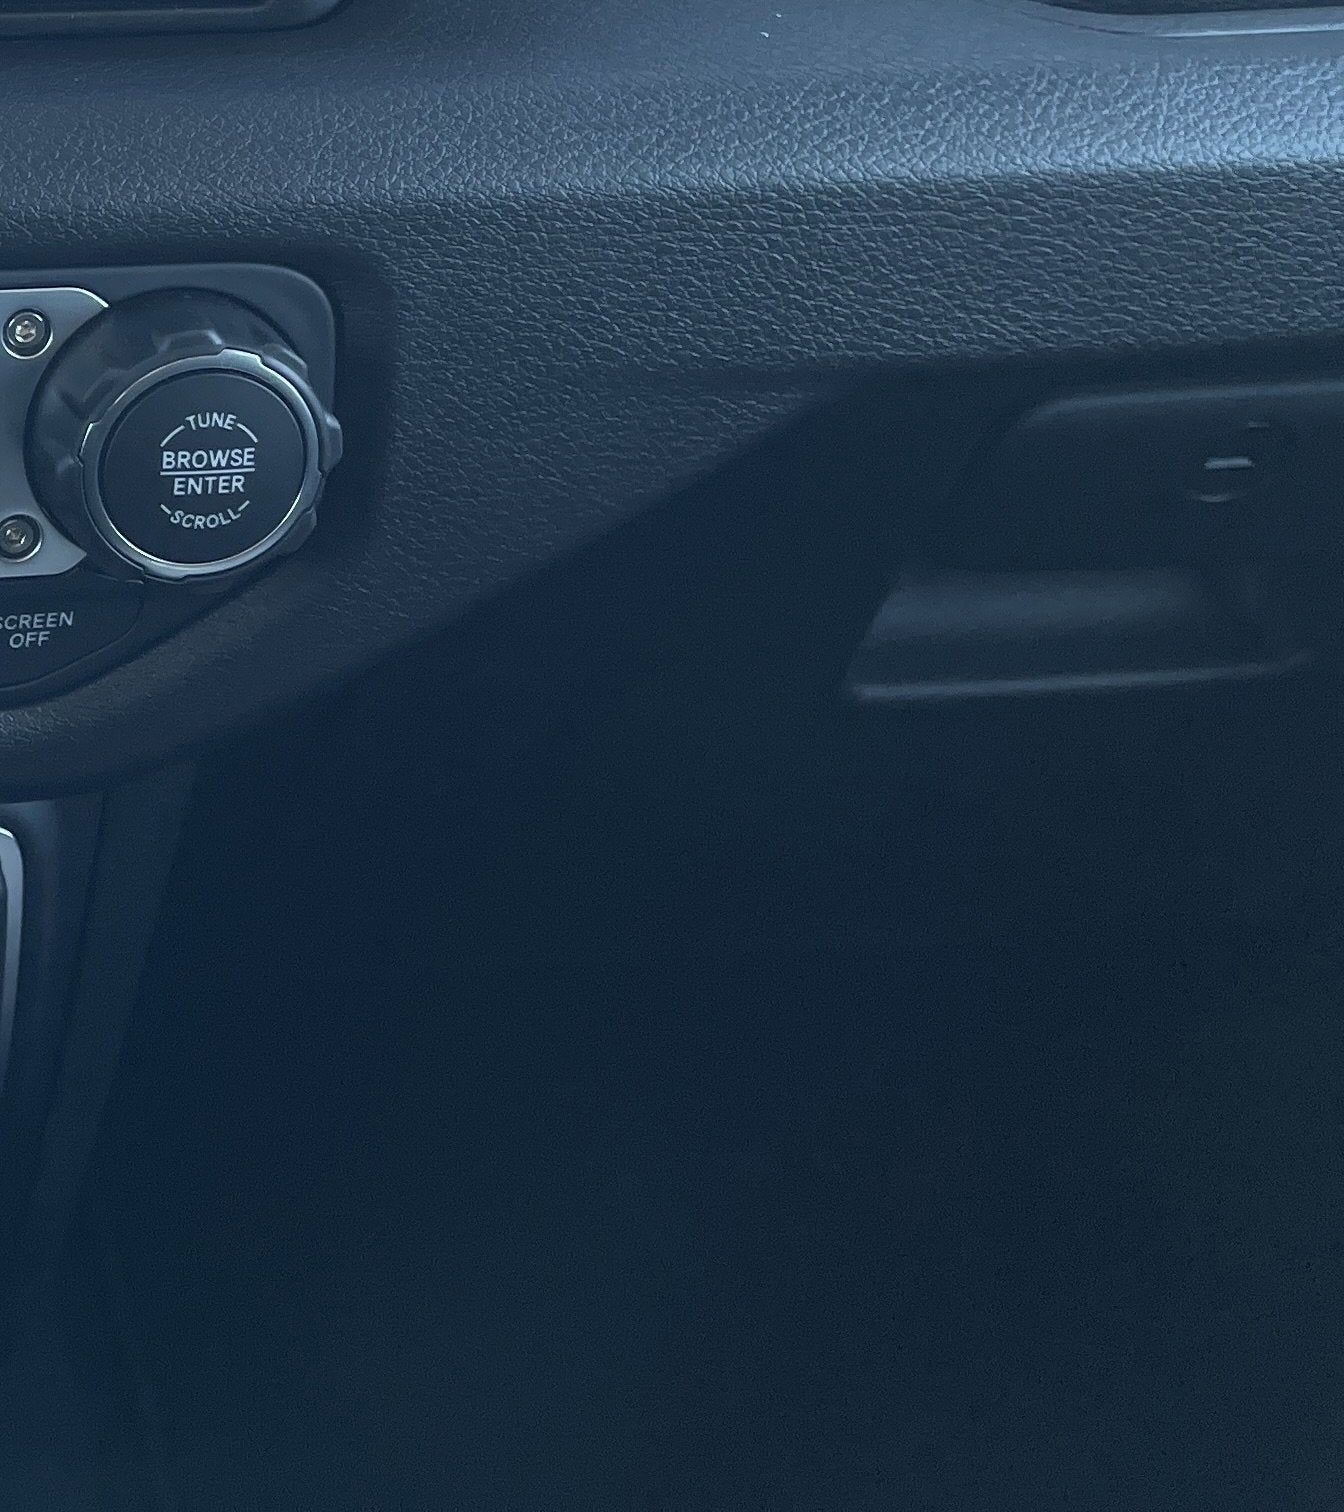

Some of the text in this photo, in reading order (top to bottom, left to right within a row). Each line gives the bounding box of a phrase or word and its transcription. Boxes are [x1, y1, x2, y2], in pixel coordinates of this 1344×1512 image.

[184, 411, 240, 432] TUNE
[160, 446, 257, 471] BROWSE
[172, 474, 246, 497] ENTER
[168, 507, 242, 531] SCROLL
[8, 630, 51, 649] OFF
